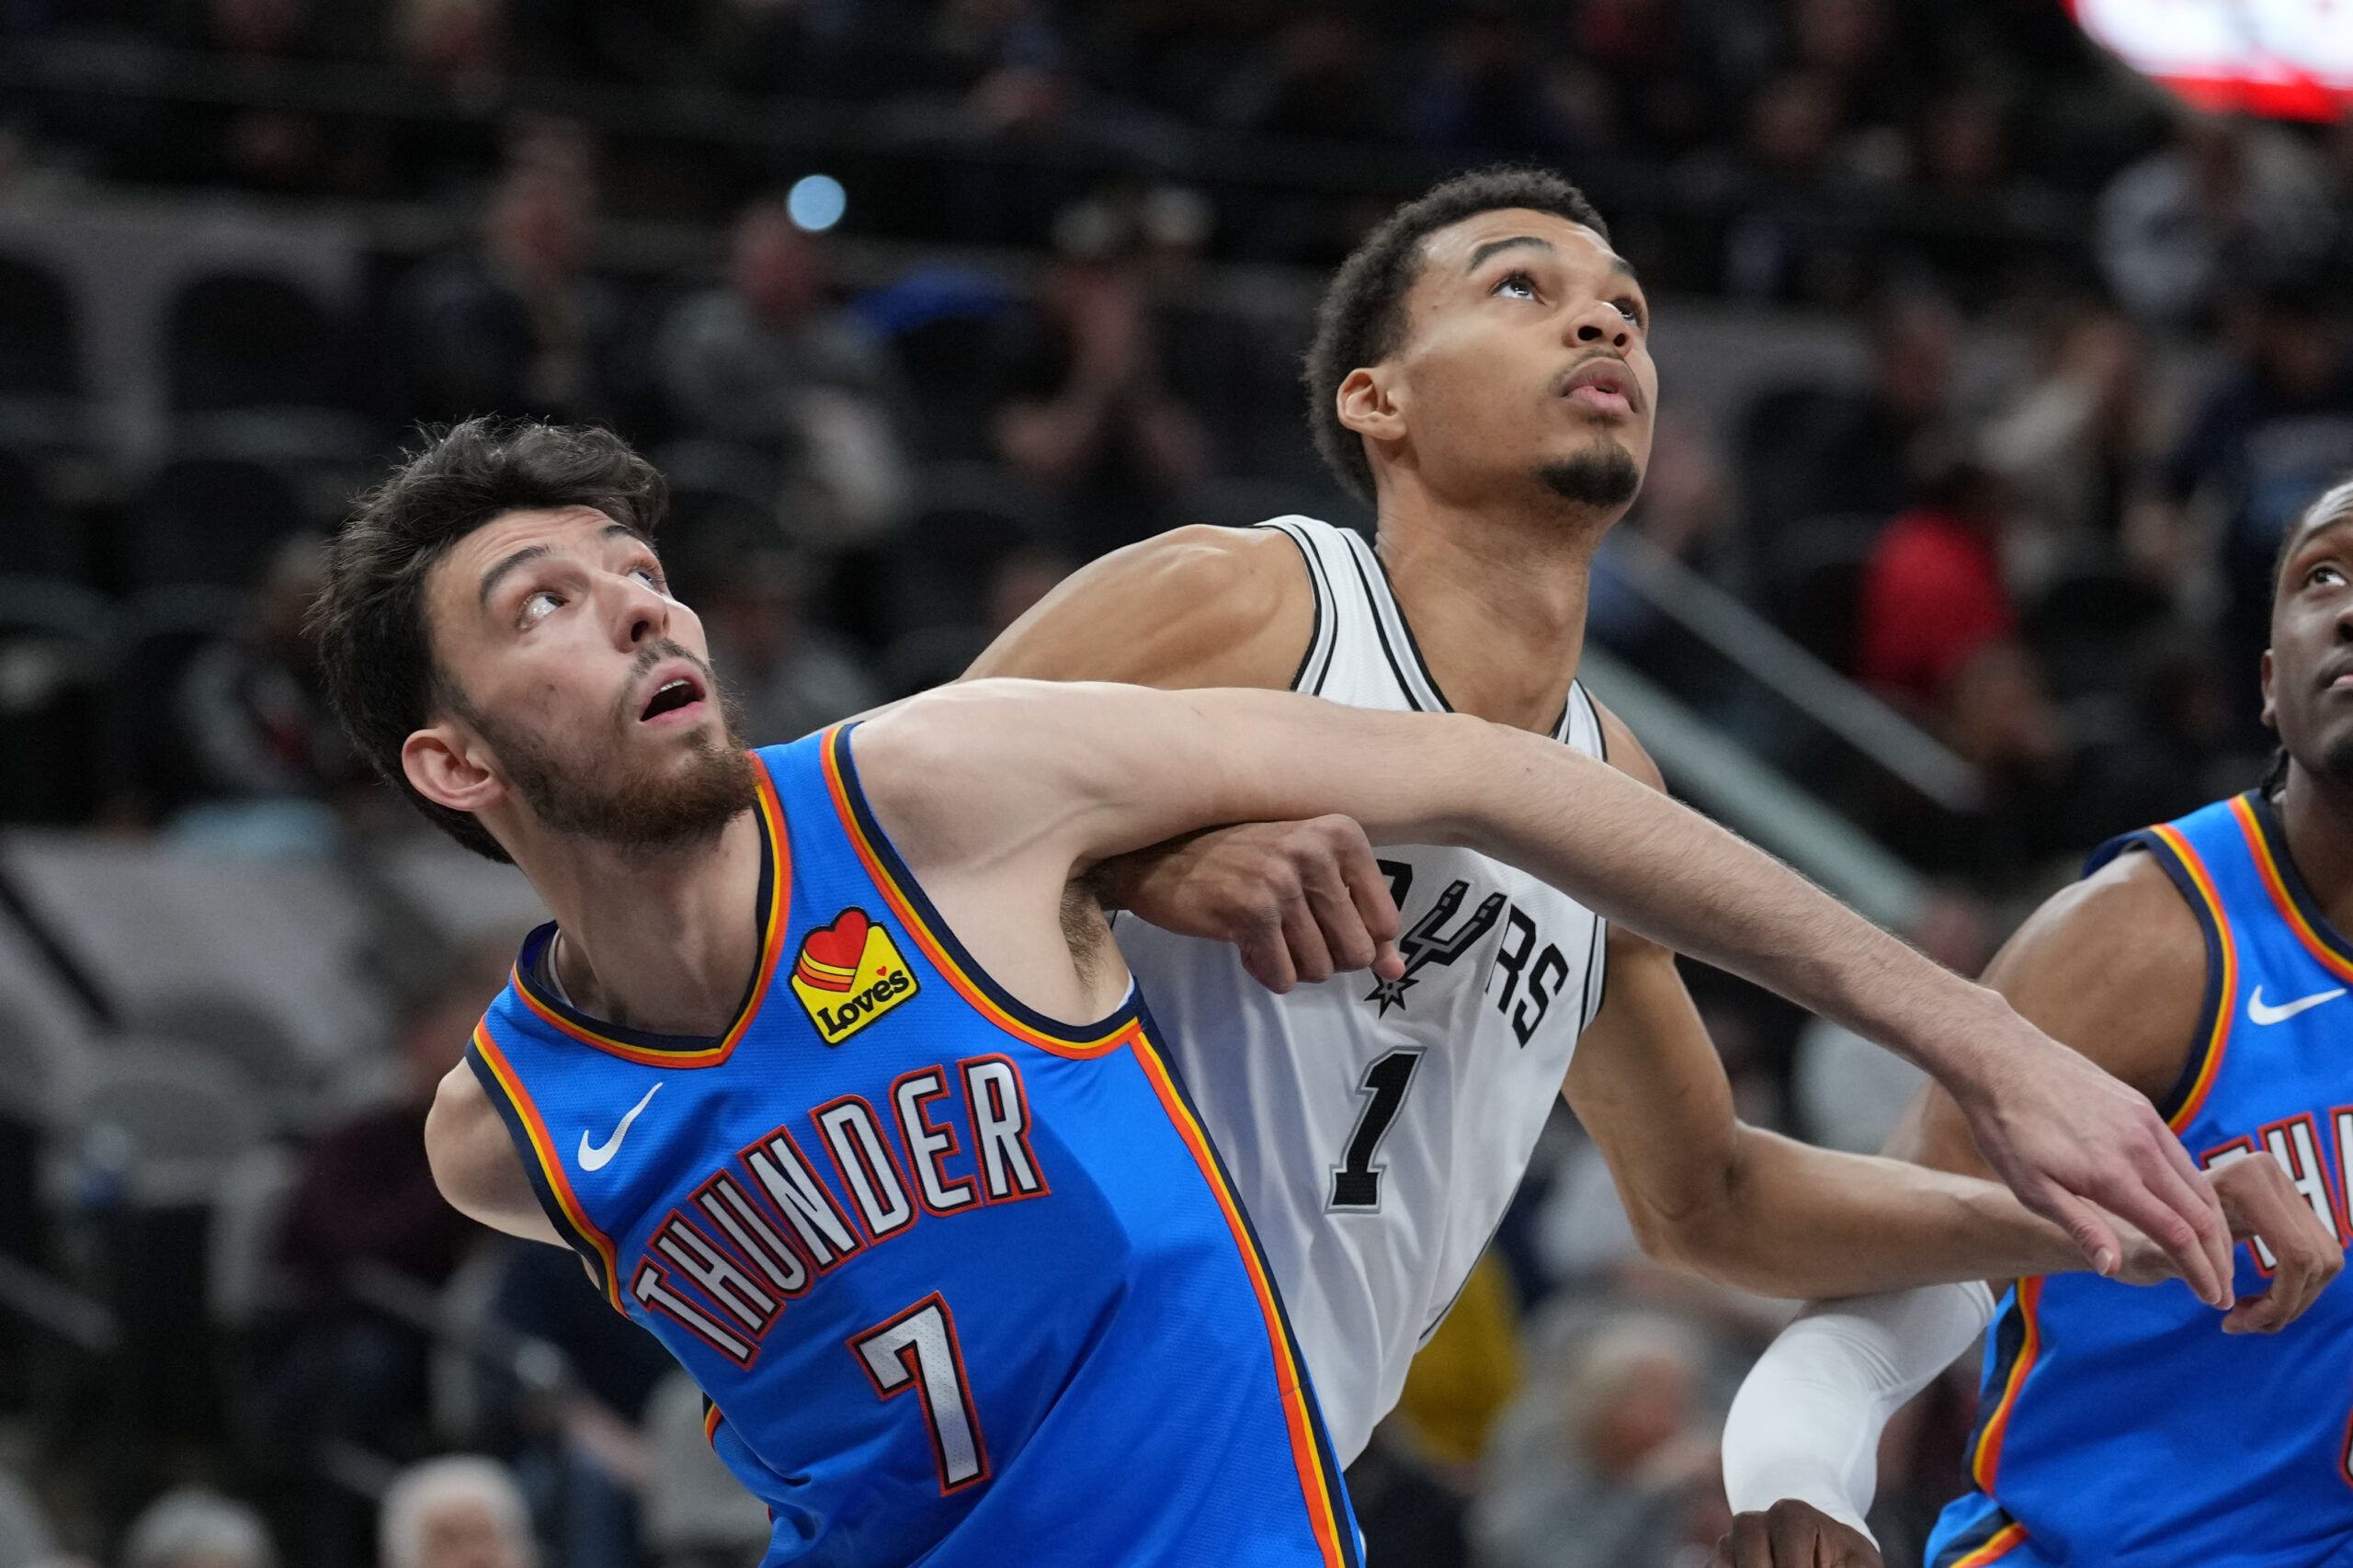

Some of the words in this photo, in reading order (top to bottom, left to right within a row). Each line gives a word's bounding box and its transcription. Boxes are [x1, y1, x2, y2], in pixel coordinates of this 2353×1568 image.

[1364, 858, 1569, 1049] URS
[630, 1053, 1051, 1370] THUNDER
[1324, 1046, 1427, 1215] 1
[846, 1290, 990, 1497] 7
